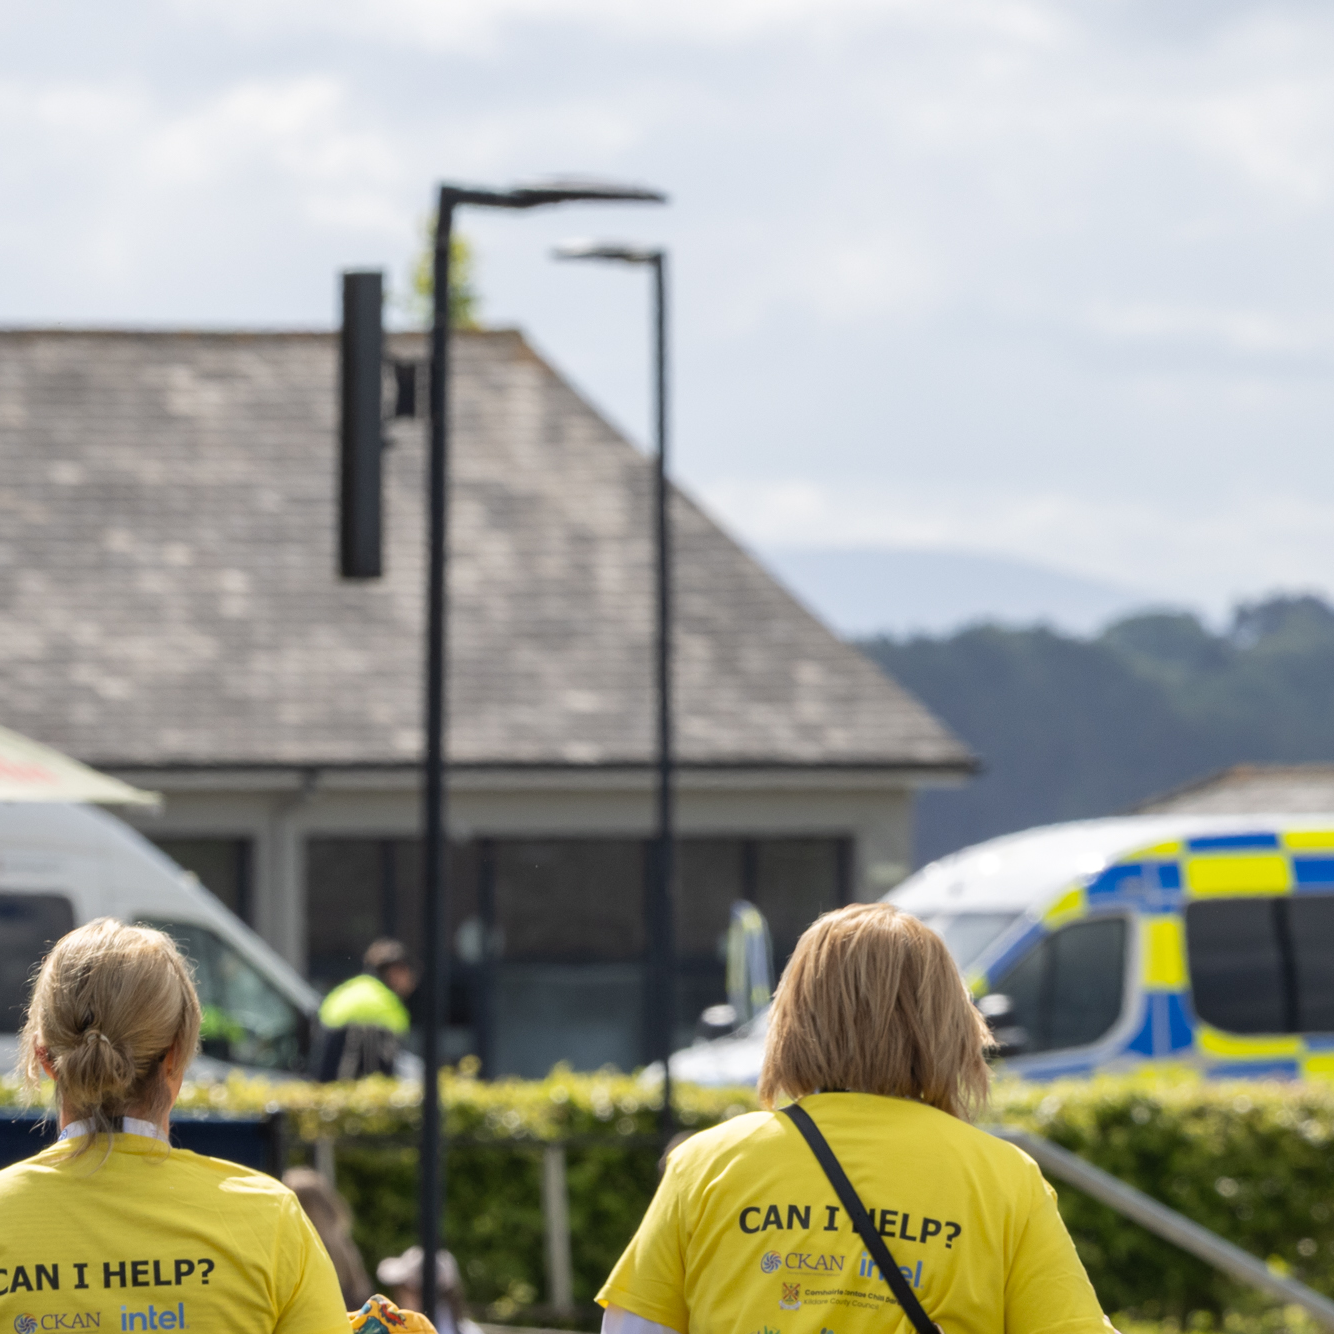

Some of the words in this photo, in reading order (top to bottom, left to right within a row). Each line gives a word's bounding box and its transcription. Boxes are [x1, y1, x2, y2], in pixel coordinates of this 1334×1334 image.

[739, 1204, 811, 1234] CAN
[823, 1205, 840, 1231] I
[73, 1262, 89, 1290] I
[103, 1258, 215, 1288] HELP?
[785, 1252, 846, 1272] CKAN
[859, 1251, 923, 1288] inel
[41, 1312, 101, 1330] CKAN
[120, 1302, 185, 1331] intel
